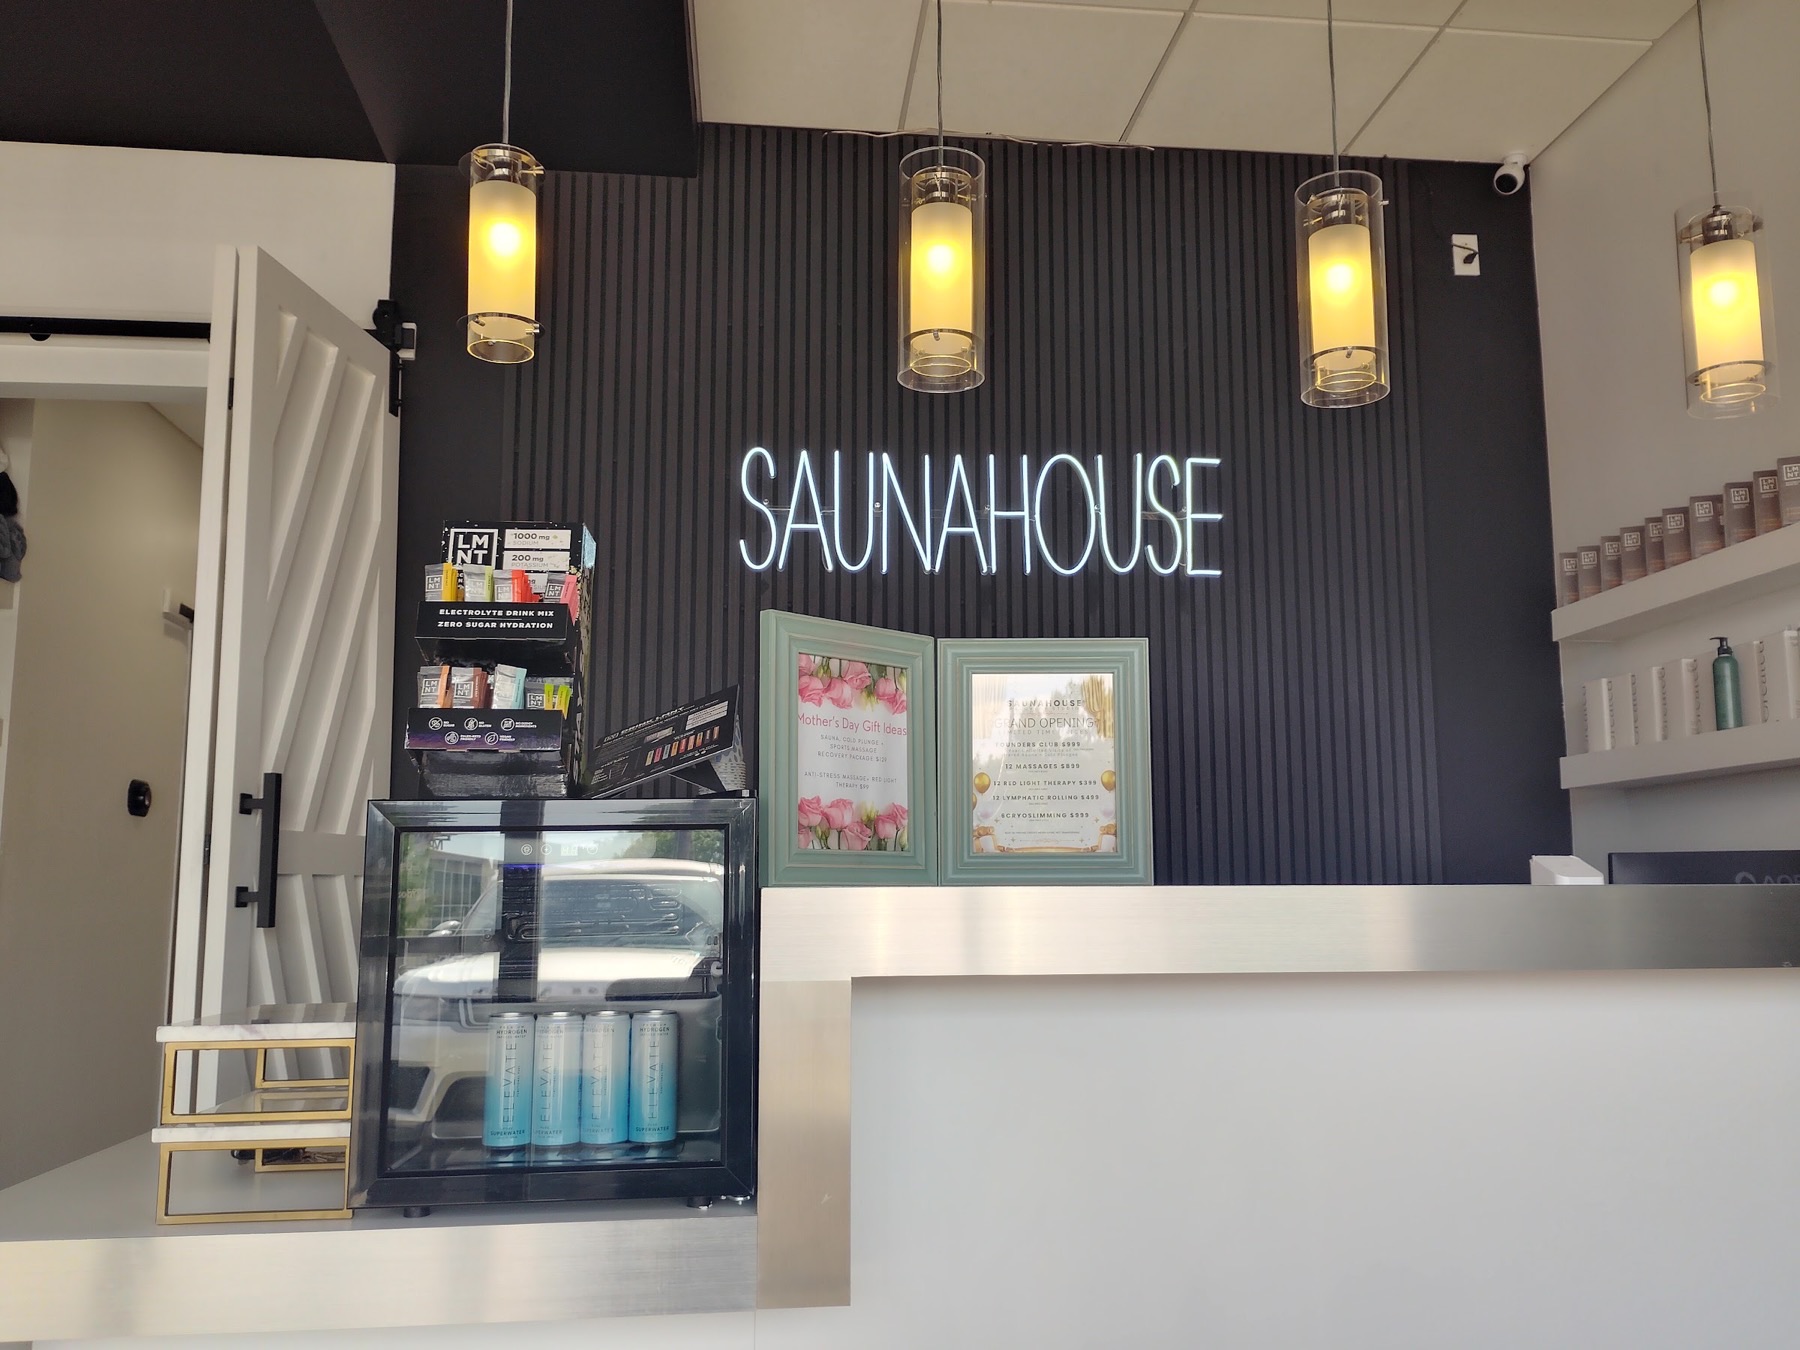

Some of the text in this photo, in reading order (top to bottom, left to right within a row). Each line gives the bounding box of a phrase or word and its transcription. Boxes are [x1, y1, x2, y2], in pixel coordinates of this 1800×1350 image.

[739, 447, 1222, 576] SAUNAHOUSE
[457, 534, 489, 549] LM
[457, 550, 488, 564] NT
[511, 554, 531, 562] 200
[798, 713, 907, 736] Mother's Day Gift Ideas
[995, 717, 1094, 728] GRAND OPENING
[850, 754, 873, 762] PACKAGE
[804, 771, 840, 779] ANTI-STRESS
[503, 1042, 517, 1123] ELEVATE
[540, 1041, 553, 1122] ELEVATE
